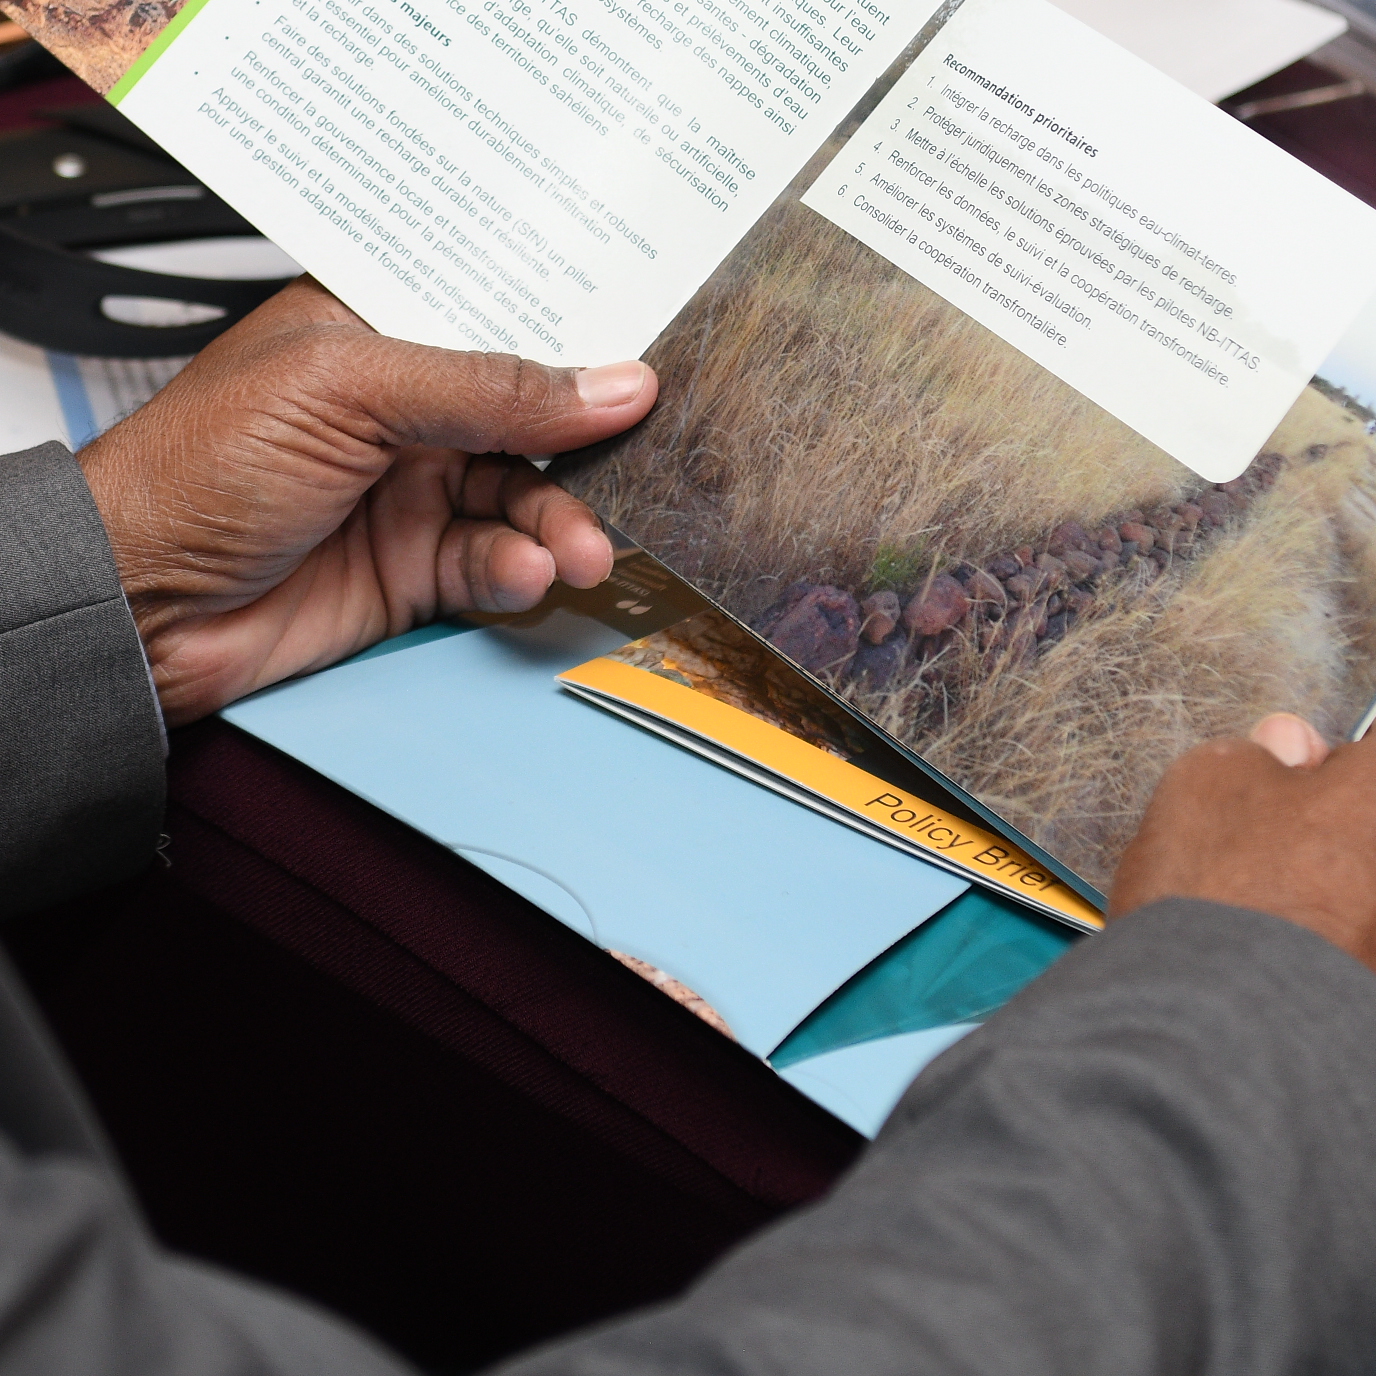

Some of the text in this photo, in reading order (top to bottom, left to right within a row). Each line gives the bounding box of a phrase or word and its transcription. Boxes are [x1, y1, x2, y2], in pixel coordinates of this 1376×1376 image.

[304, 4, 320, 23] la
[317, 18, 375, 72] recharge.
[398, 0, 453, 48] majeurs
[580, 28, 654, 93] démontrent
[655, 92, 683, 118] que
[685, 115, 702, 134] la
[704, 134, 757, 181] maîtrise
[770, 0, 849, 73] insuffisantes
[941, 51, 1100, 159] Recommandations prioritaires
[360, 5, 394, 35] dans
[392, 31, 419, 56] des
[416, 51, 474, 103] solutions
[472, 97, 541, 160] techniques
[538, 156, 590, 202] simples
[588, 198, 606, 214] et
[601, 210, 659, 261] robustes
[905, 95, 1234, 321] 2. Protéger juridiquement les zones stratégiques de recharge.
[925, 74, 1238, 288] 1. Intégrer la recharge dans les politiques eau-climat-terres.
[835, 182, 1068, 350] 6. Consolider la coopération transfrontalière.
[852, 160, 1092, 332] 5. Améliorer les systèmes de suivi-évaluation.
[871, 140, 1229, 389] 4. Renforcer les données, le suivi et la coopération transfrontalière.
[888, 117, 1261, 374] 3. Mettre à l’échelle les solutions éprouvées par les pilotes NB-ITTAS.
[864, 792, 1060, 892] Policy Brief
